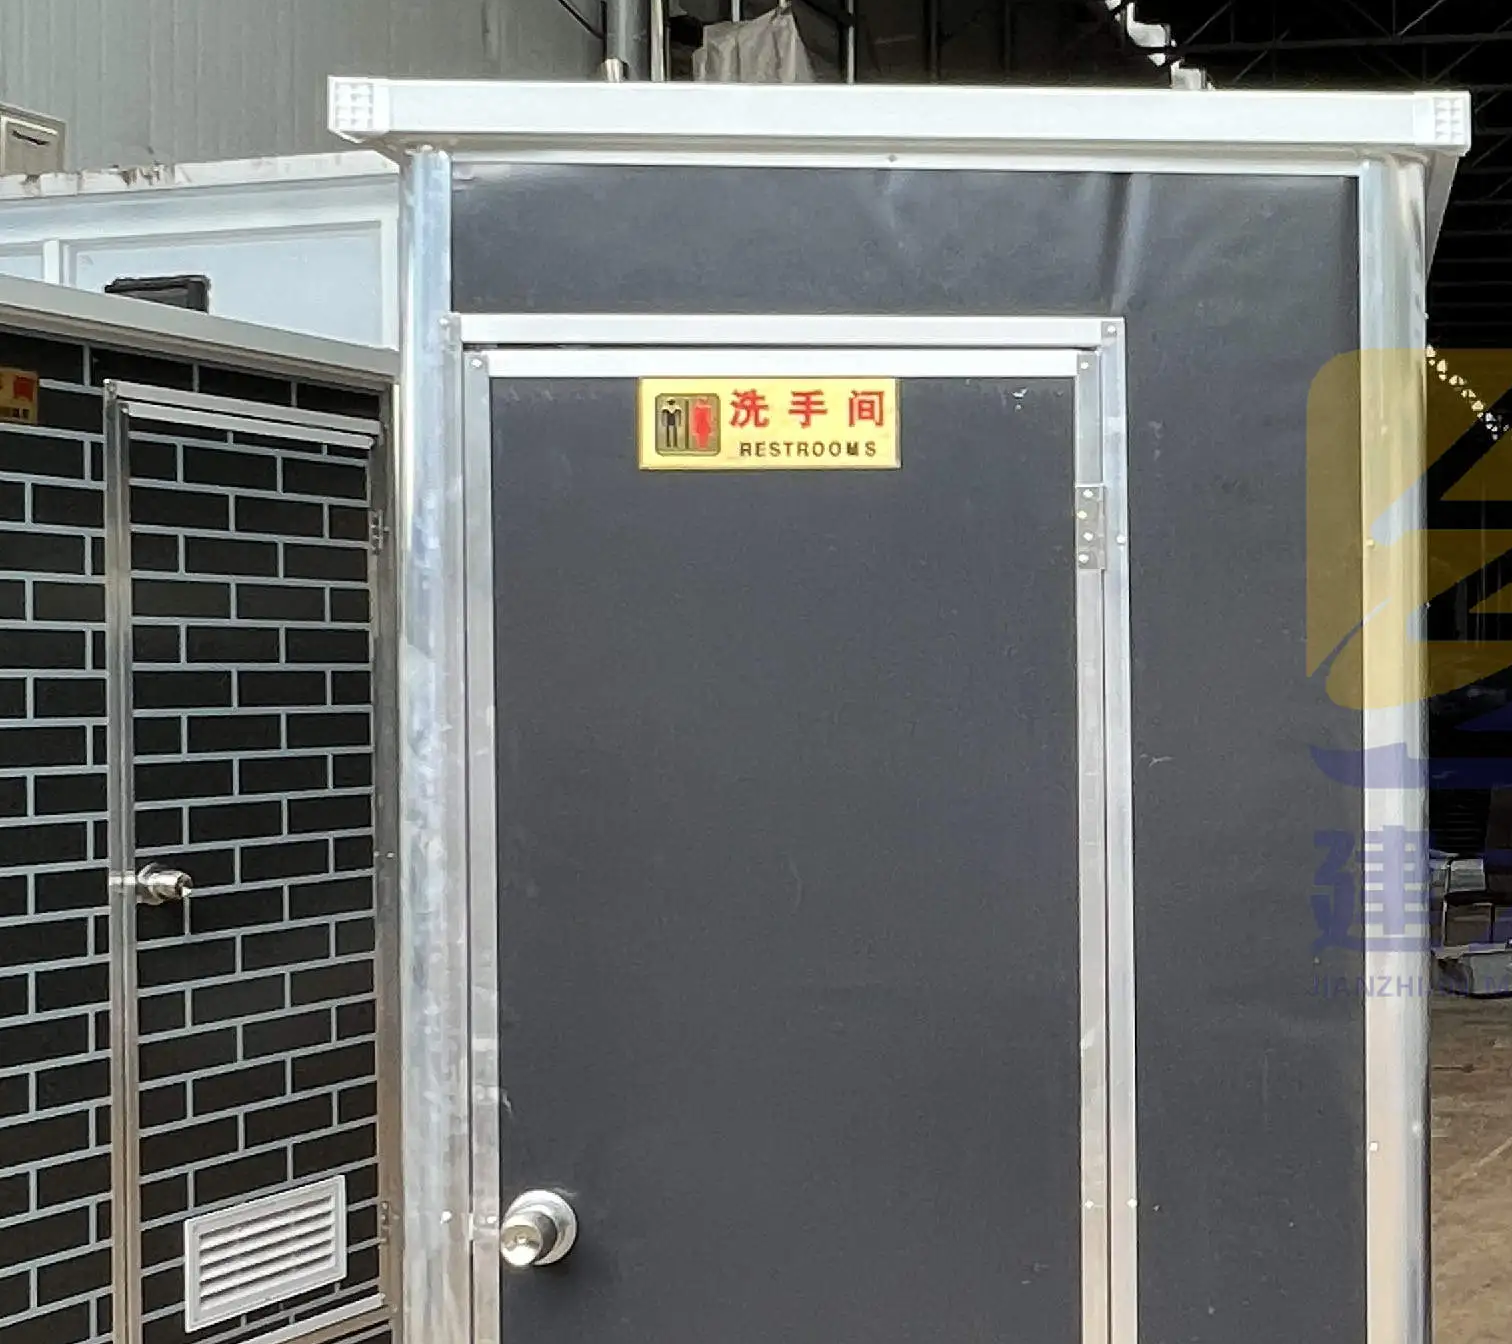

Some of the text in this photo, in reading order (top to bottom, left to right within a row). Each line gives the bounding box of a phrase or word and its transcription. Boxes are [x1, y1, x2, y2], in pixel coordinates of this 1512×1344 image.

[729, 388, 886, 428] 洗手间
[739, 441, 878, 458] RESTROOMS
